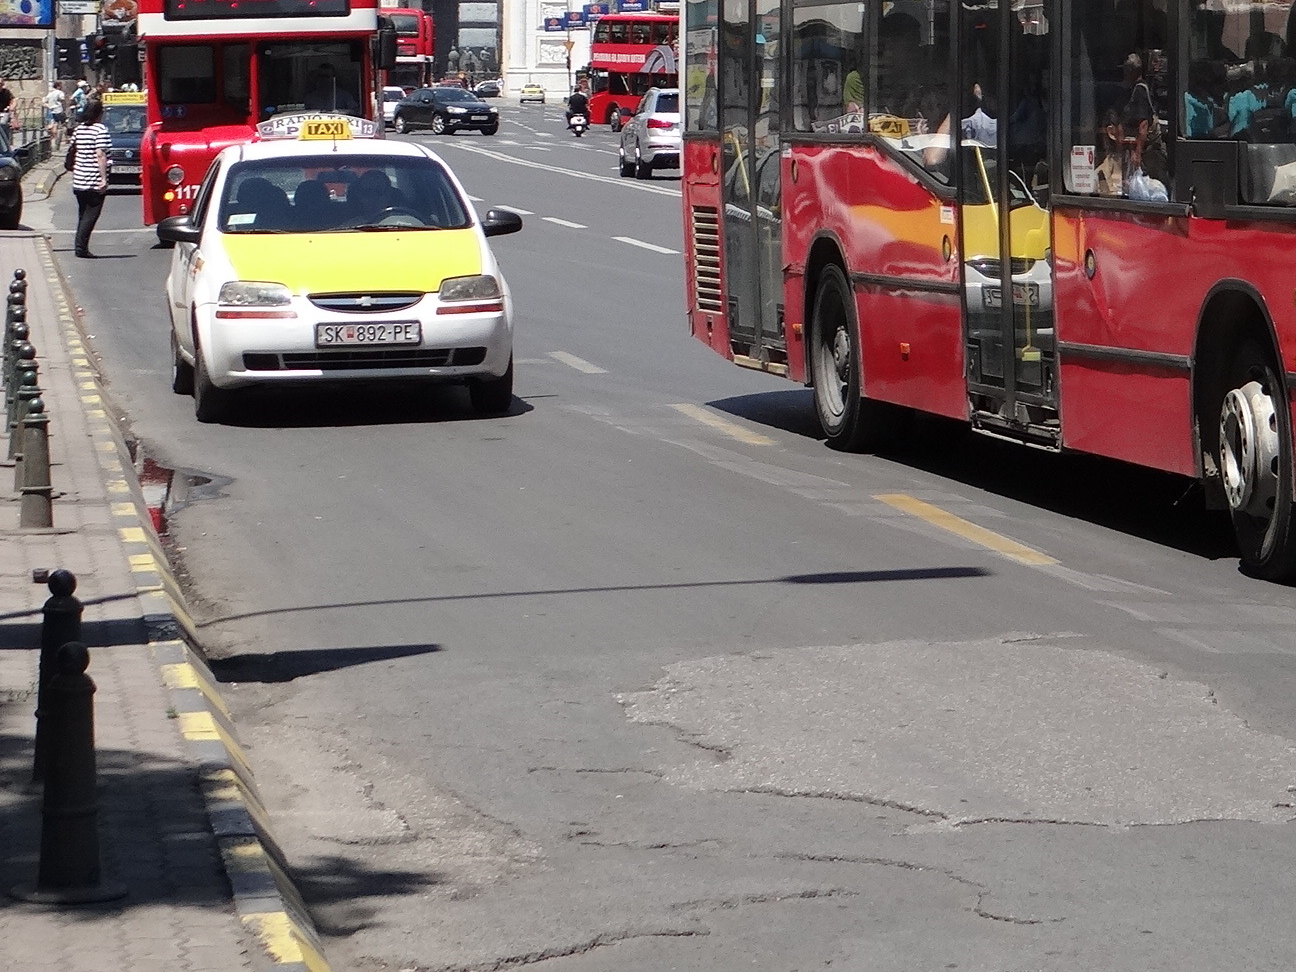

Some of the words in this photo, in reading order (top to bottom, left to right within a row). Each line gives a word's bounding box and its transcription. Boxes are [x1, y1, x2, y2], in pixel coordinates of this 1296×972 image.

[275, 114, 321, 129] RADIO
[308, 123, 344, 135] TAXI
[362, 124, 372, 134] 13
[325, 326, 344, 342] SK
[356, 324, 412, 342] 892-PE
